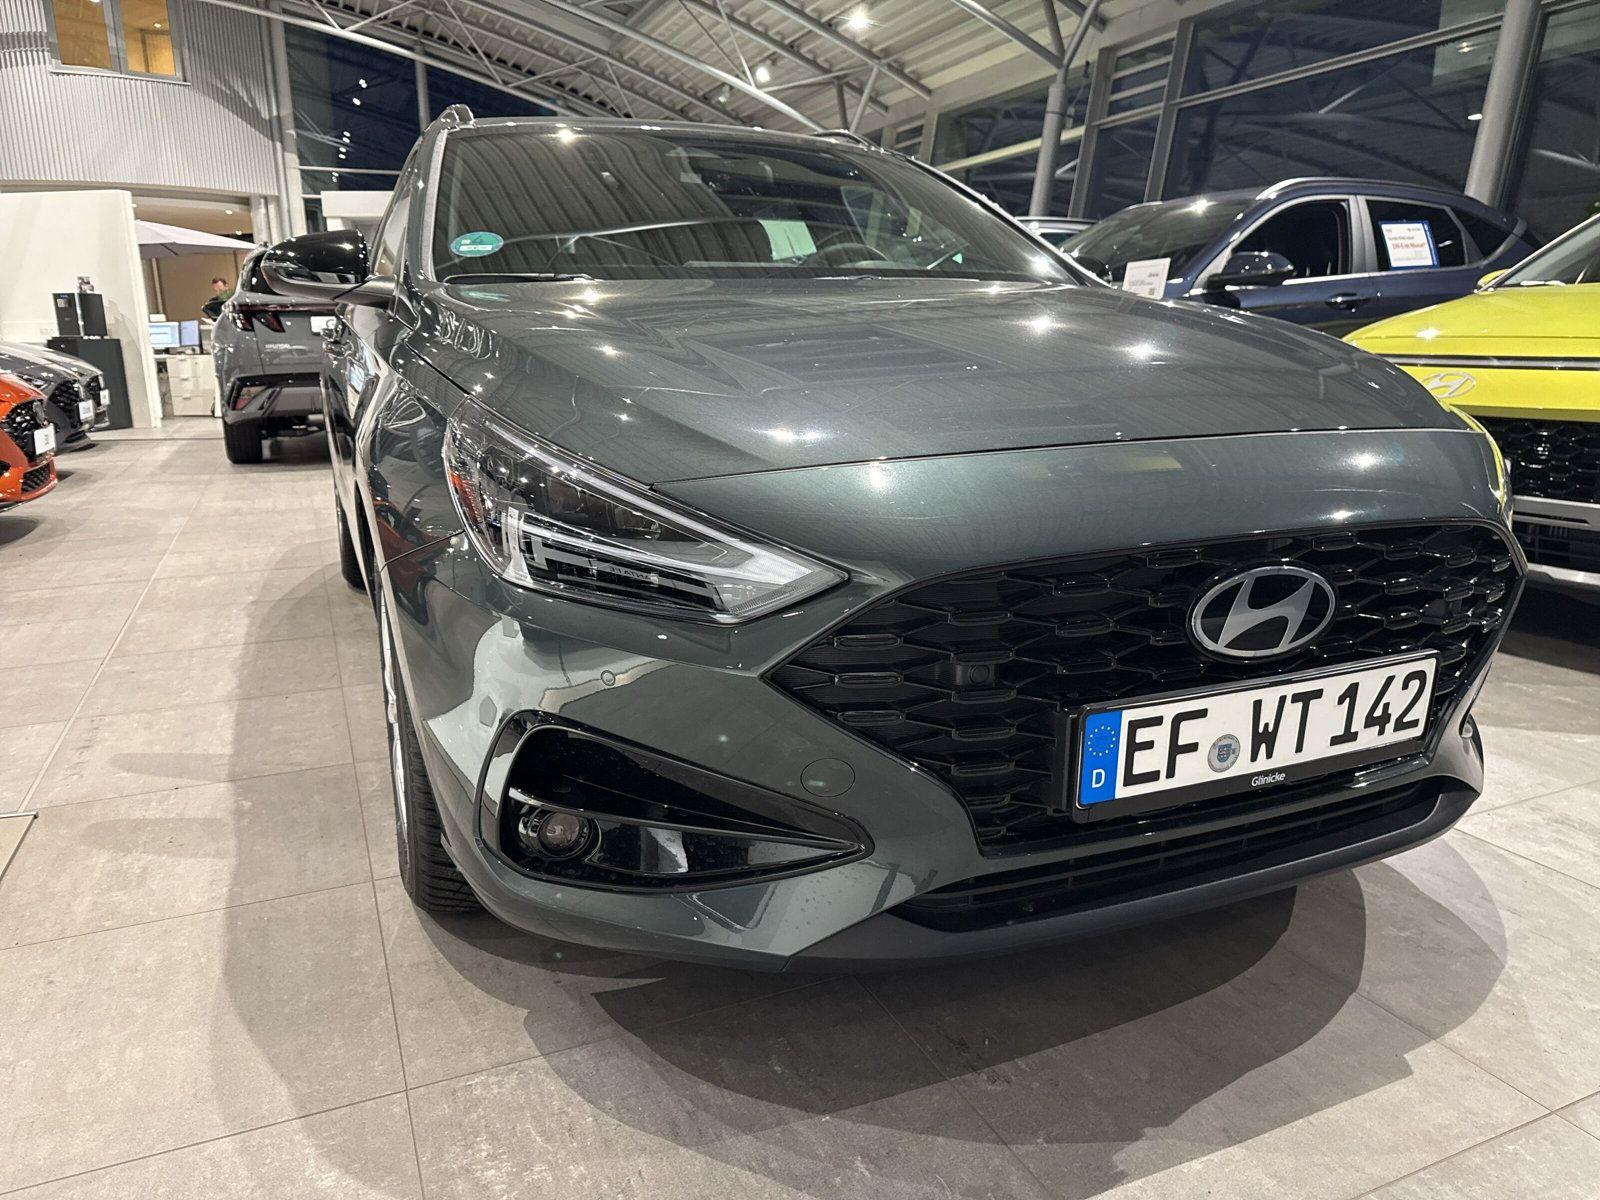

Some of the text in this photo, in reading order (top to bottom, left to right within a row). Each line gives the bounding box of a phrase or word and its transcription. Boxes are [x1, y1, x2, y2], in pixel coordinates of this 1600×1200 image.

[1122, 707, 1209, 787] EF
[1250, 688, 1324, 763] WT
[1329, 669, 1428, 747] 142
[1091, 768, 1106, 789] D
[1250, 771, 1286, 787] Glinicke
